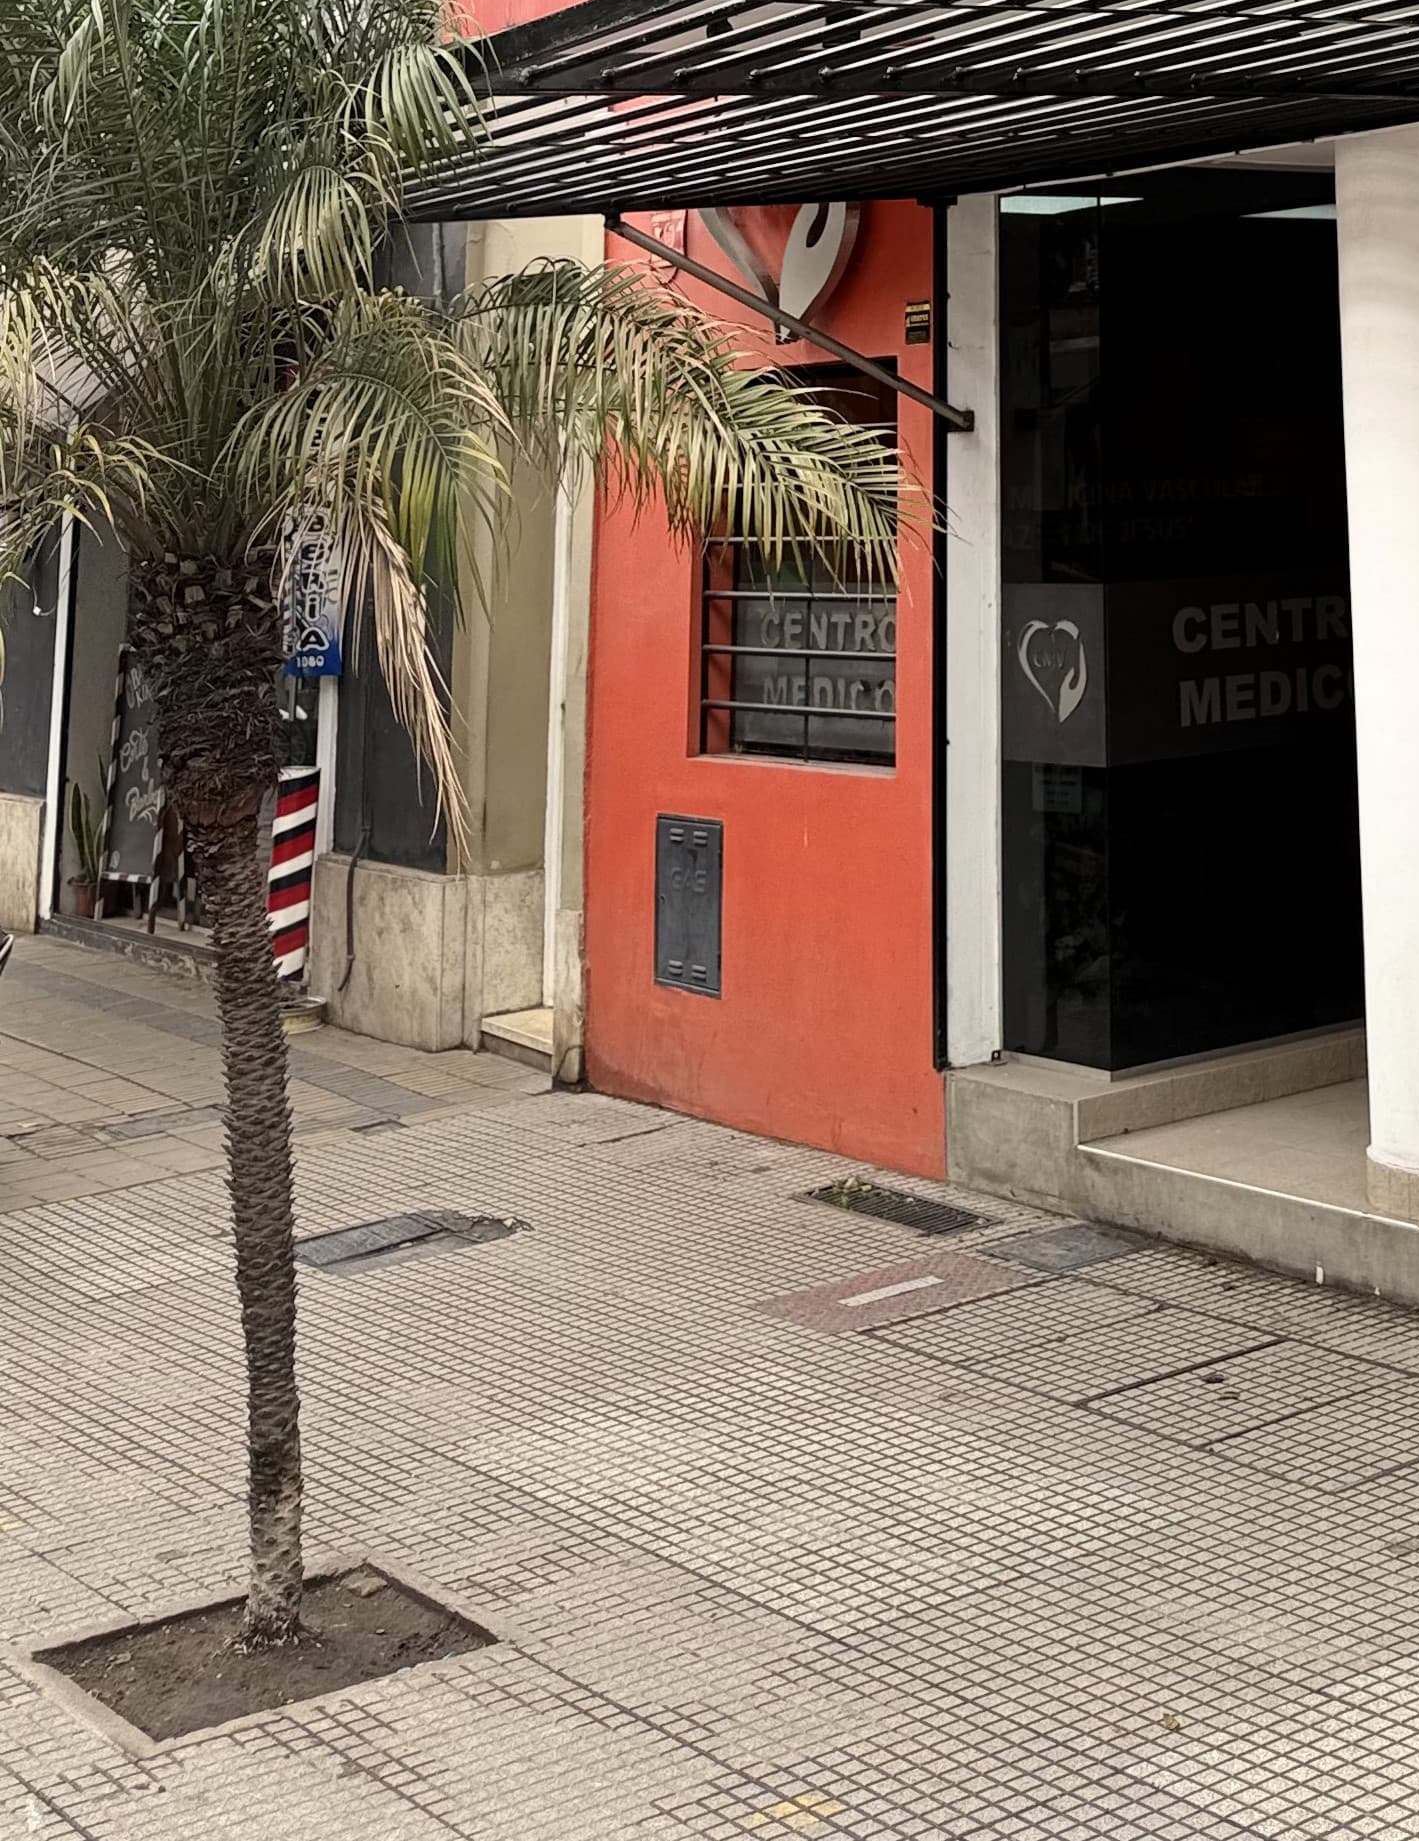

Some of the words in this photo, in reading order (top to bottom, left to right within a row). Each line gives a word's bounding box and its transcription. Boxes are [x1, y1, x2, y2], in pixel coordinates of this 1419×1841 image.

[760, 611, 897, 653] CENTRO
[1172, 595, 1350, 653] CENTR
[1179, 663, 1352, 727] MEDIC
